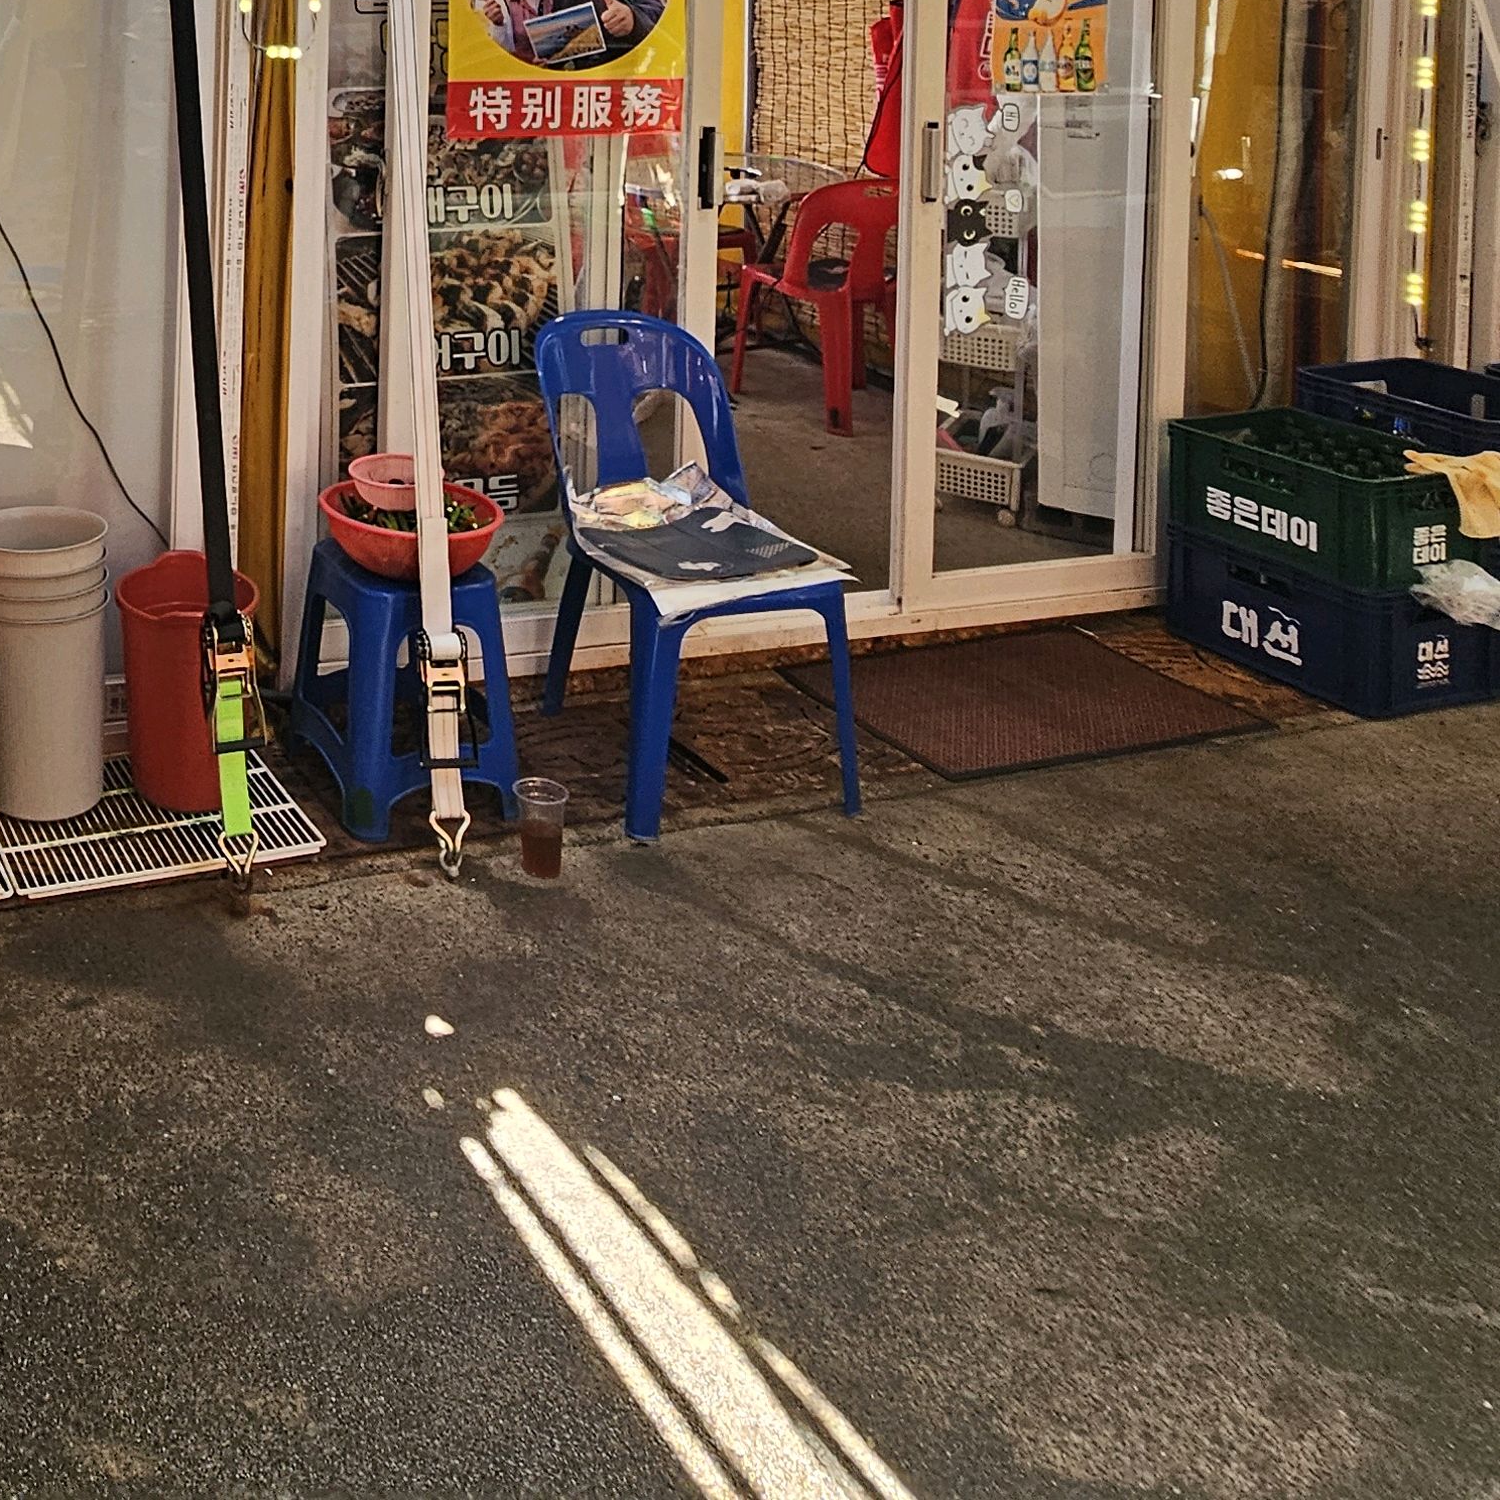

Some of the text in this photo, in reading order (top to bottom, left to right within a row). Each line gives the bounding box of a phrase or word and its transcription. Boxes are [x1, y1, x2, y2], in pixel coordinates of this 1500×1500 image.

[1206, 486, 1318, 552] 좋은데이
[1414, 525, 1447, 544] 좋은
[1413, 543, 1447, 565] 데이
[1222, 601, 1303, 666] 대선
[1417, 636, 1450, 663] 대선
